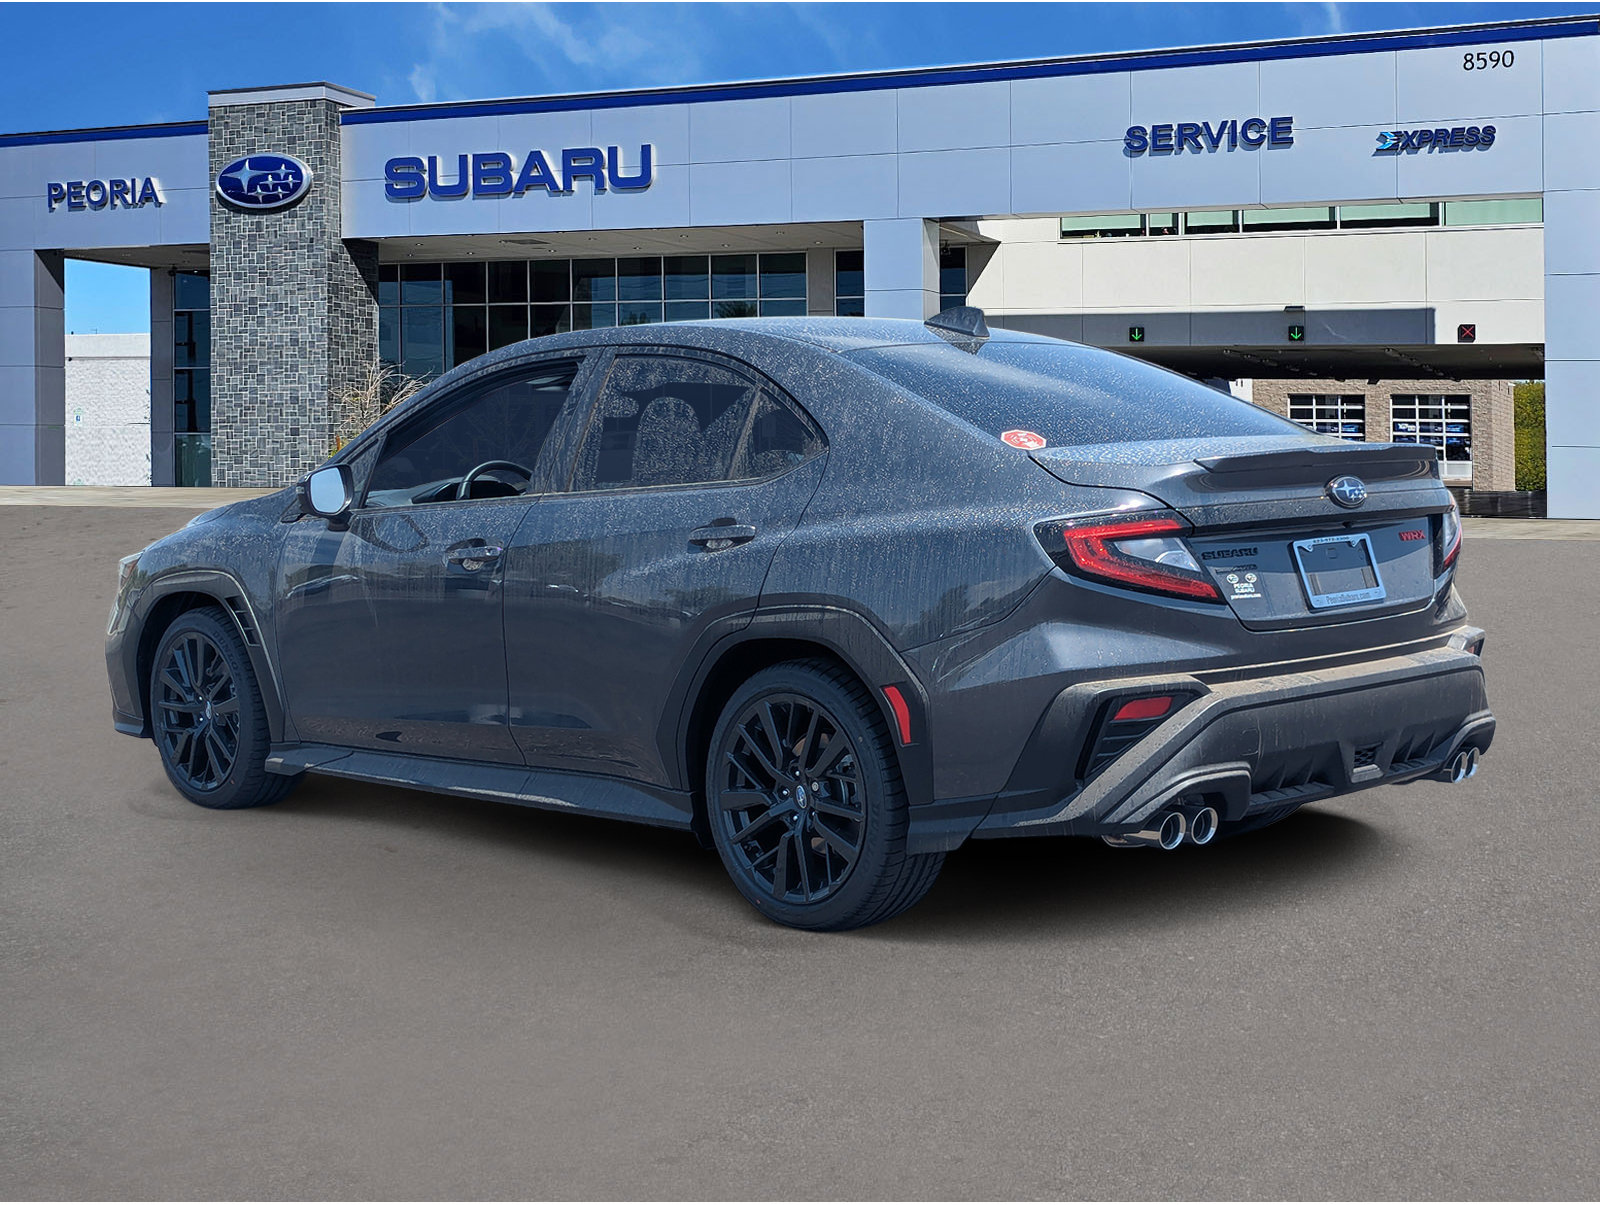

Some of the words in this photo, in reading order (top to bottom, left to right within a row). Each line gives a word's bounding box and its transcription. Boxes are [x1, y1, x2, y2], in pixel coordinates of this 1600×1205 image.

[1463, 49, 1515, 71] 8590
[1124, 116, 1294, 155] SERVICE
[1375, 125, 1497, 152] EXPRESS
[385, 144, 653, 201] SUBARU
[47, 177, 161, 211] PEORIA
[1398, 529, 1427, 542] WRX
[1201, 547, 1258, 560] SUBARU
